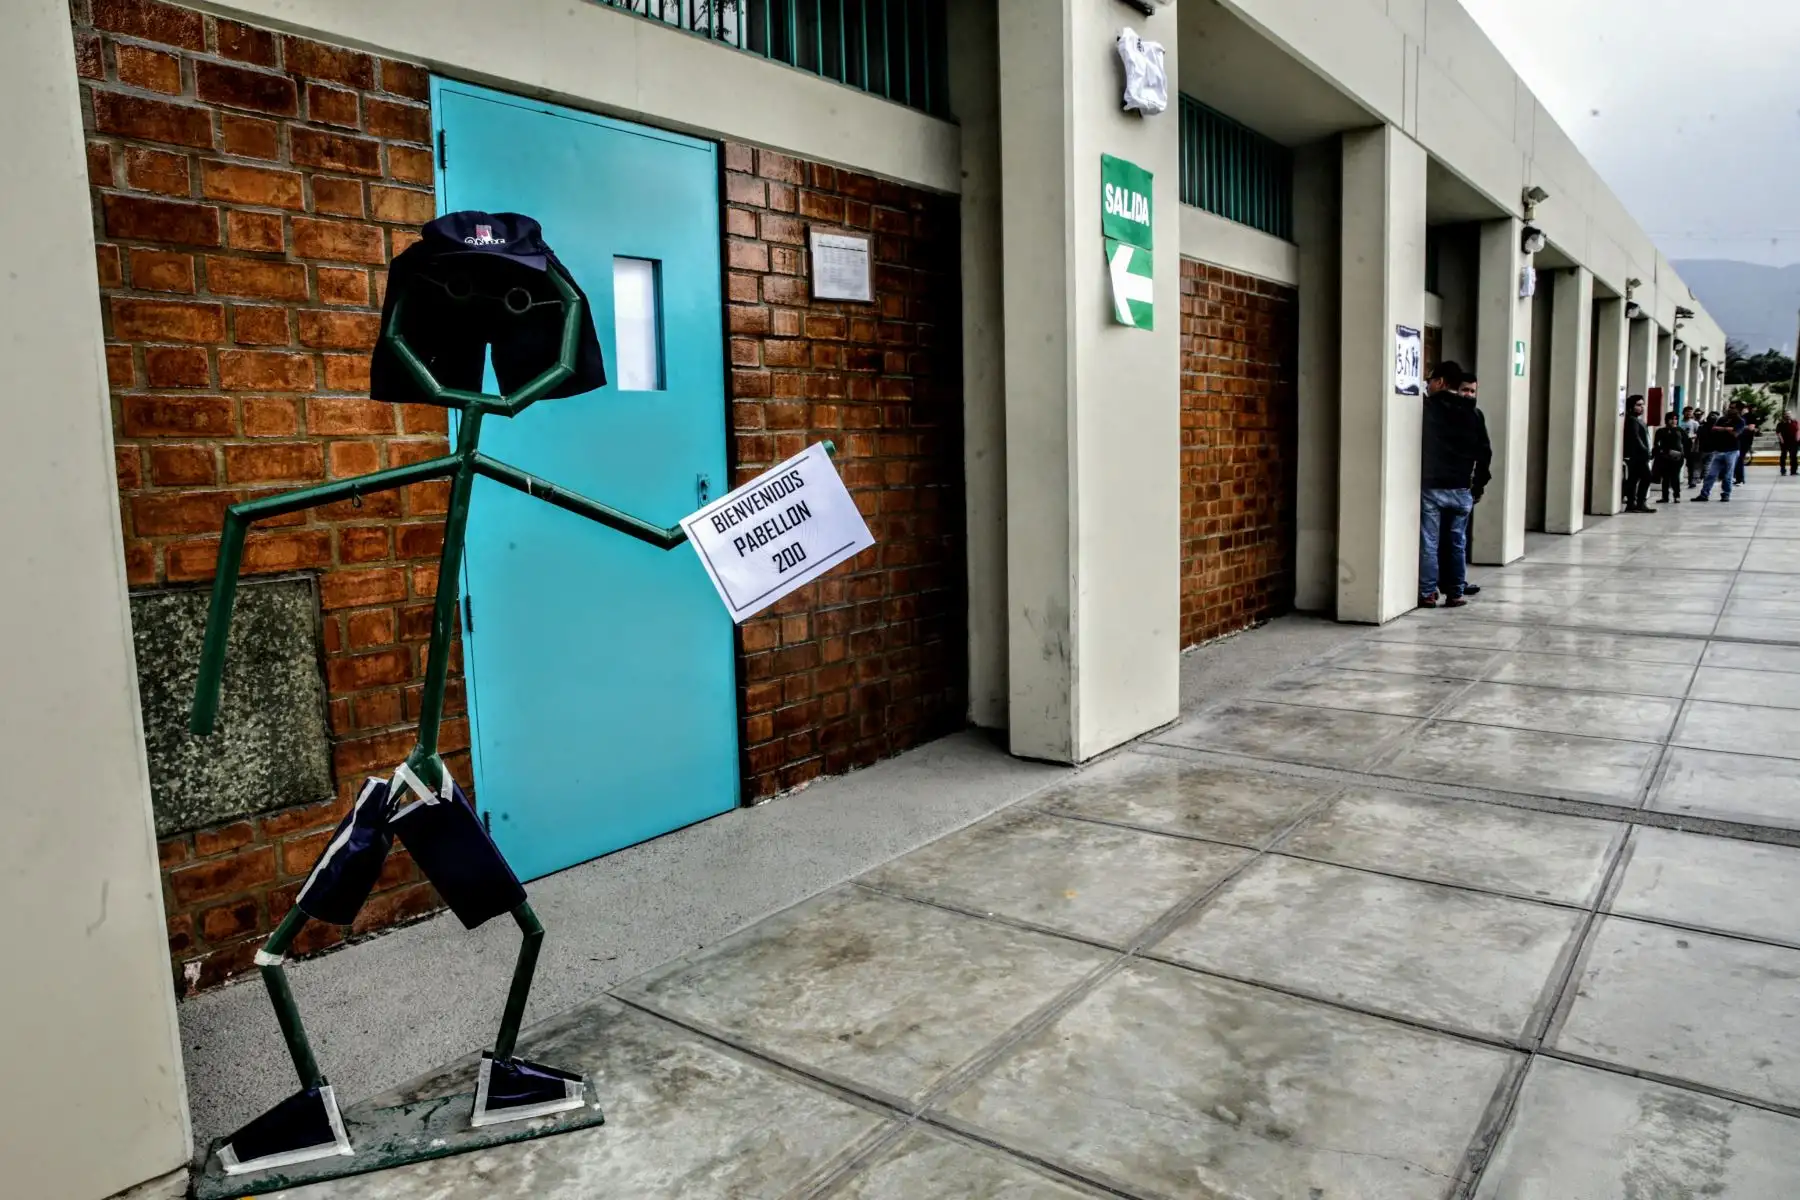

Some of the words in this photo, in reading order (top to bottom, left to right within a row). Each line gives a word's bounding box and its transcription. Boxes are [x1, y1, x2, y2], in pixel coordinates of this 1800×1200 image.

[1105, 182, 1150, 226] SALIDA
[710, 469, 805, 534] BIENVENIDOS
[733, 500, 812, 557] PABELLON
[772, 541, 807, 573] 200
